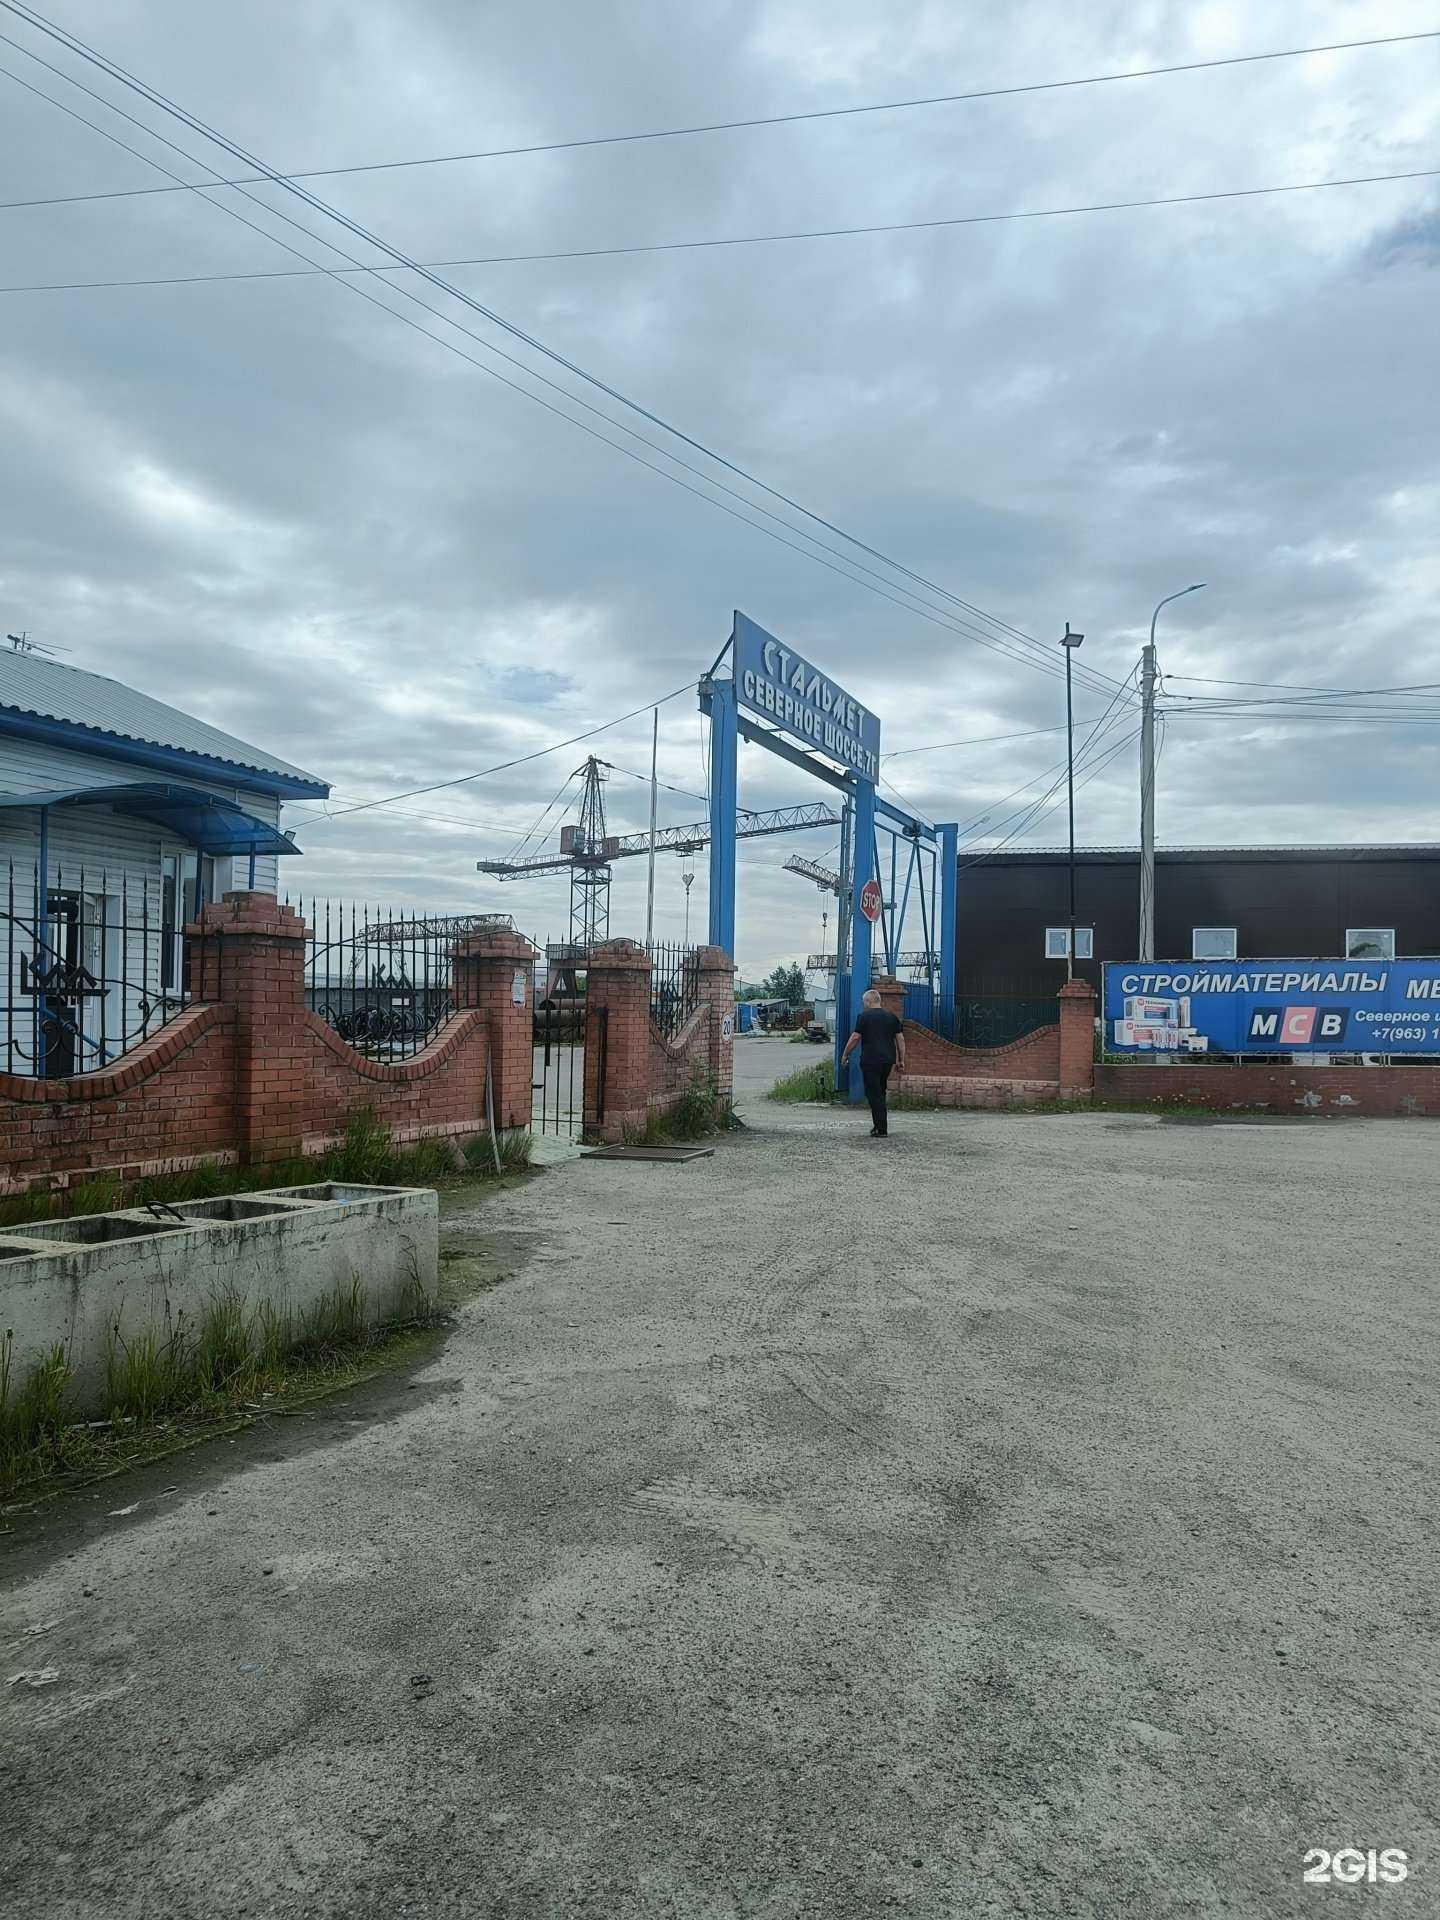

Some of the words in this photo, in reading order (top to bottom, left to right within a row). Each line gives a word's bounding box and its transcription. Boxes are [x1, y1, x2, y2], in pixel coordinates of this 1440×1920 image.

[764, 641, 866, 738] СТАЛЬМЕТ
[744, 670, 822, 741] СЕВЕРНОЕ
[862, 892, 880, 911] STOP
[1121, 970, 1387, 993] СТРОЙМАТЕРИАЛЫ
[1355, 1010, 1431, 1024] Северное
[723, 1020, 731, 1035] 20
[1372, 1027, 1427, 1042] +7(963)
